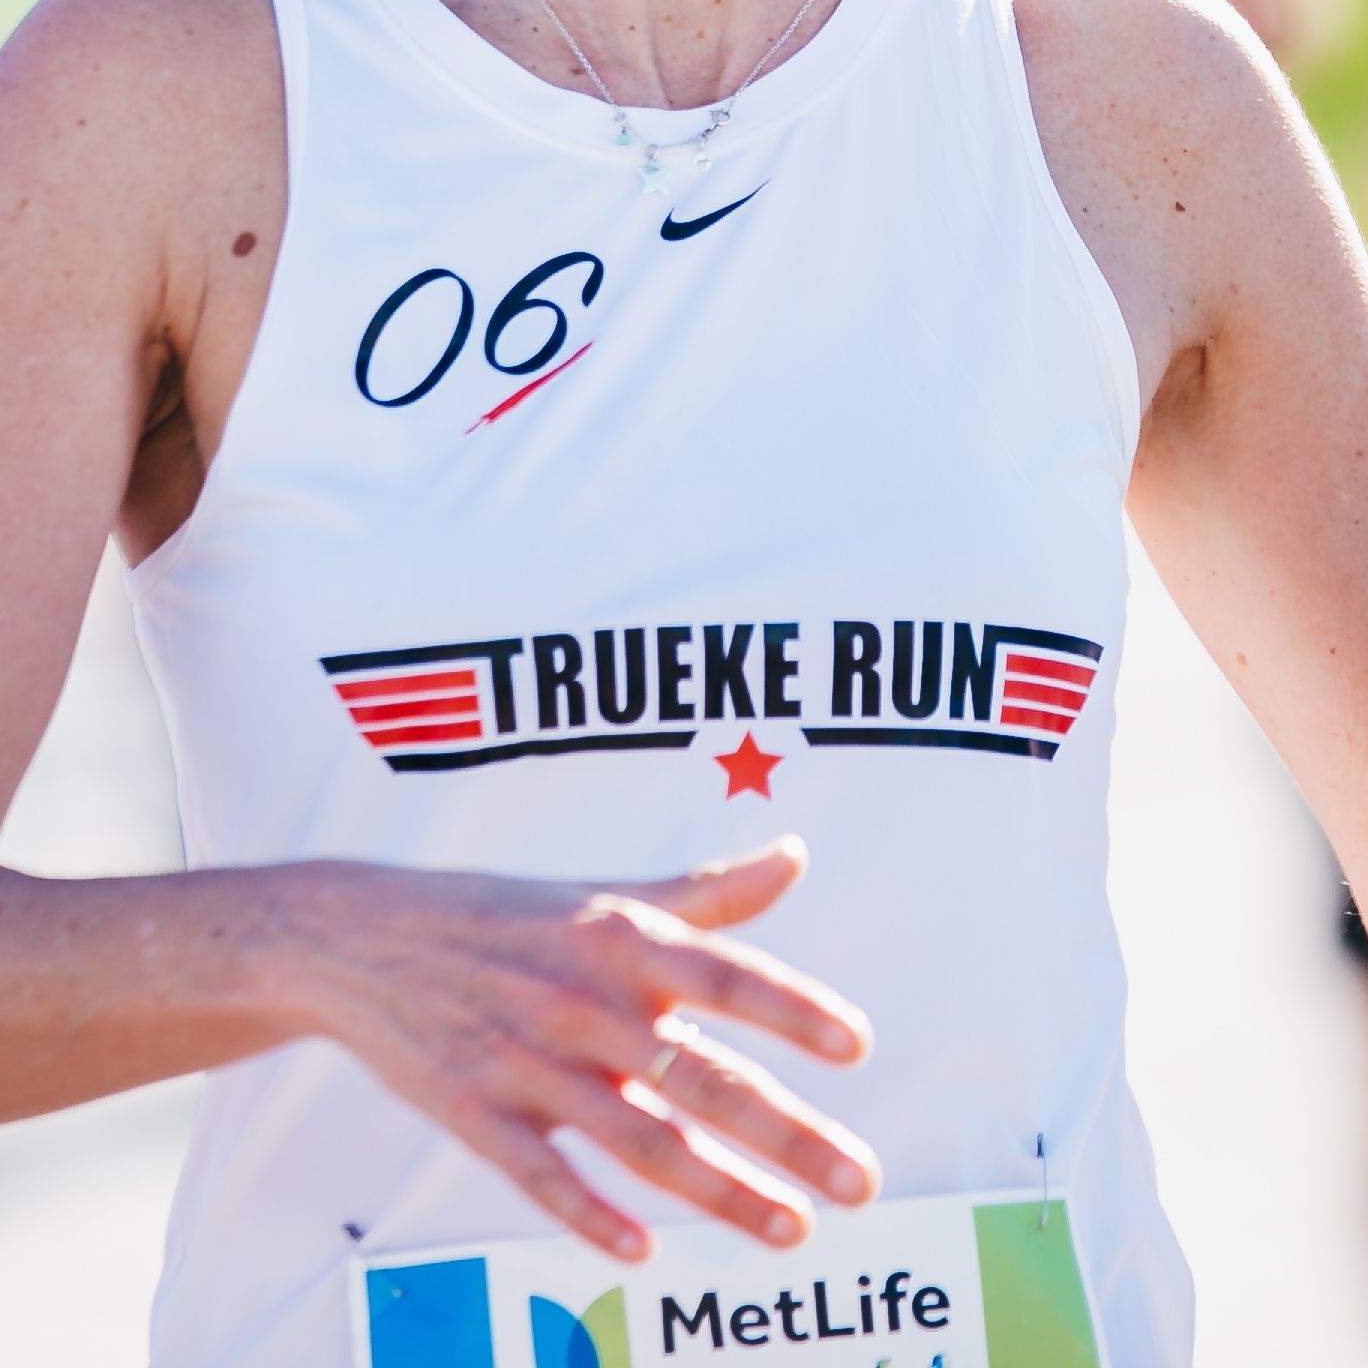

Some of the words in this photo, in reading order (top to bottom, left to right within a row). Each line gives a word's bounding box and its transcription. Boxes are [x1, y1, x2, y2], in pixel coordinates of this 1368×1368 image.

[353, 251, 605, 409] 06
[481, 621, 803, 736] TRUEKE
[831, 620, 996, 722] RUN
[659, 1270, 951, 1354] MetLife
